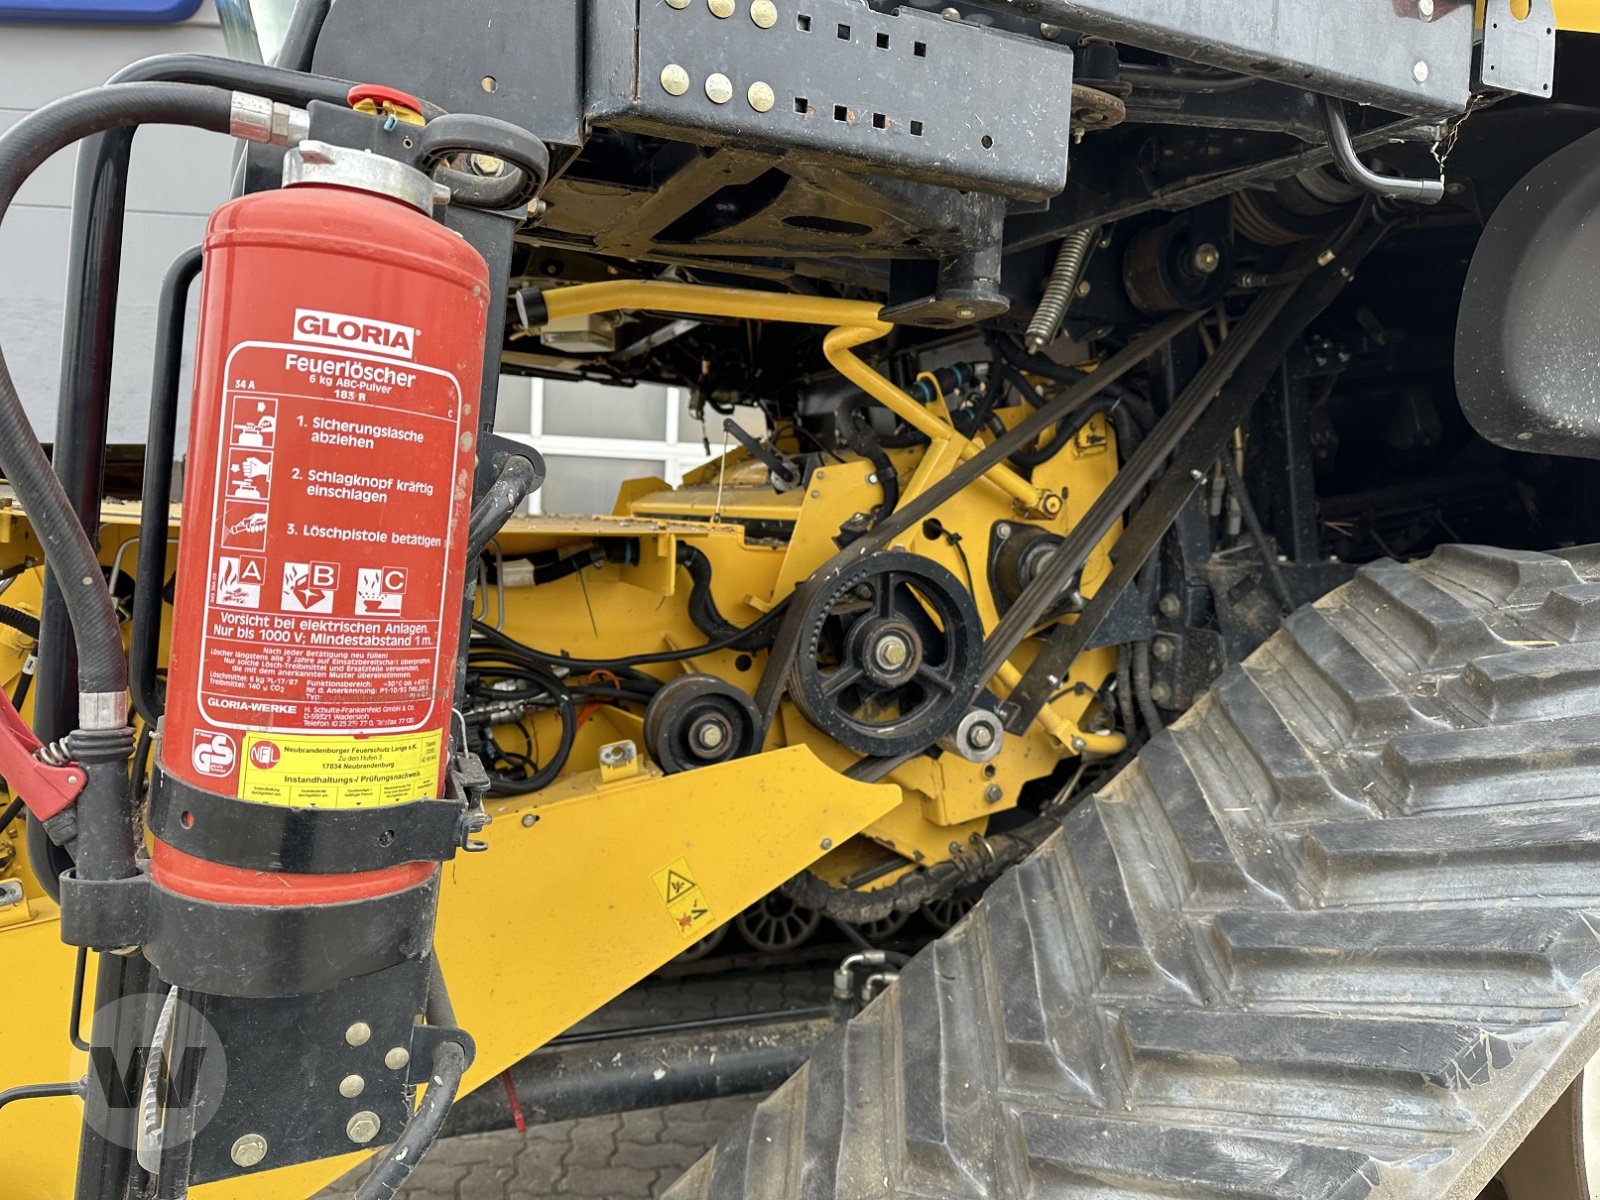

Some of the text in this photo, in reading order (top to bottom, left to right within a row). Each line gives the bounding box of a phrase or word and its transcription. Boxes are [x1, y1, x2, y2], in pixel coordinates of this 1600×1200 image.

[297, 315, 410, 350] GLORIA
[285, 353, 416, 389] Feuerlöscher
[235, 379, 255, 389] 34 A
[309, 374, 392, 394] 6 kg ABC-Pulver
[296, 415, 424, 443] 1. Sicherungslasche
[311, 431, 374, 449] abziehen
[291, 468, 434, 496] 2. Schlagknopf kräftig
[306, 484, 388, 503] einschlagen
[287, 523, 441, 548] 3. Löschpistole betätigen
[241, 560, 261, 580] A
[313, 565, 334, 586] B
[384, 571, 404, 590] C
[221, 612, 429, 636] Vorsicht bei elektrischen Anlagen.
[213, 624, 233, 637] Nur
[237, 627, 254, 639] bis
[259, 630, 290, 642] 1000
[294, 632, 306, 645] V;
[310, 633, 411, 646] Mindestabstand
[211, 648, 232, 657] Löscher
[235, 652, 268, 661] längstens
[271, 654, 284, 662] alle
[238, 659, 259, 667] solche
[284, 649, 303, 657] jeder
[306, 650, 348, 659] Betätigung
[210, 671, 248, 682] Löschmittel:
[210, 678, 245, 688] Treibmittel:
[307, 680, 373, 688] Funktionsbereich:
[208, 698, 297, 714] GLORIA-WERKE
[304, 719, 329, 727] Telefon
[194, 736, 233, 773] GS
[250, 746, 279, 763] NFL
[284, 746, 349, 754] Neubrandenburger
[343, 762, 395, 770] Neubrandenburg
[361, 771, 420, 782] Prüfungsnachweis
